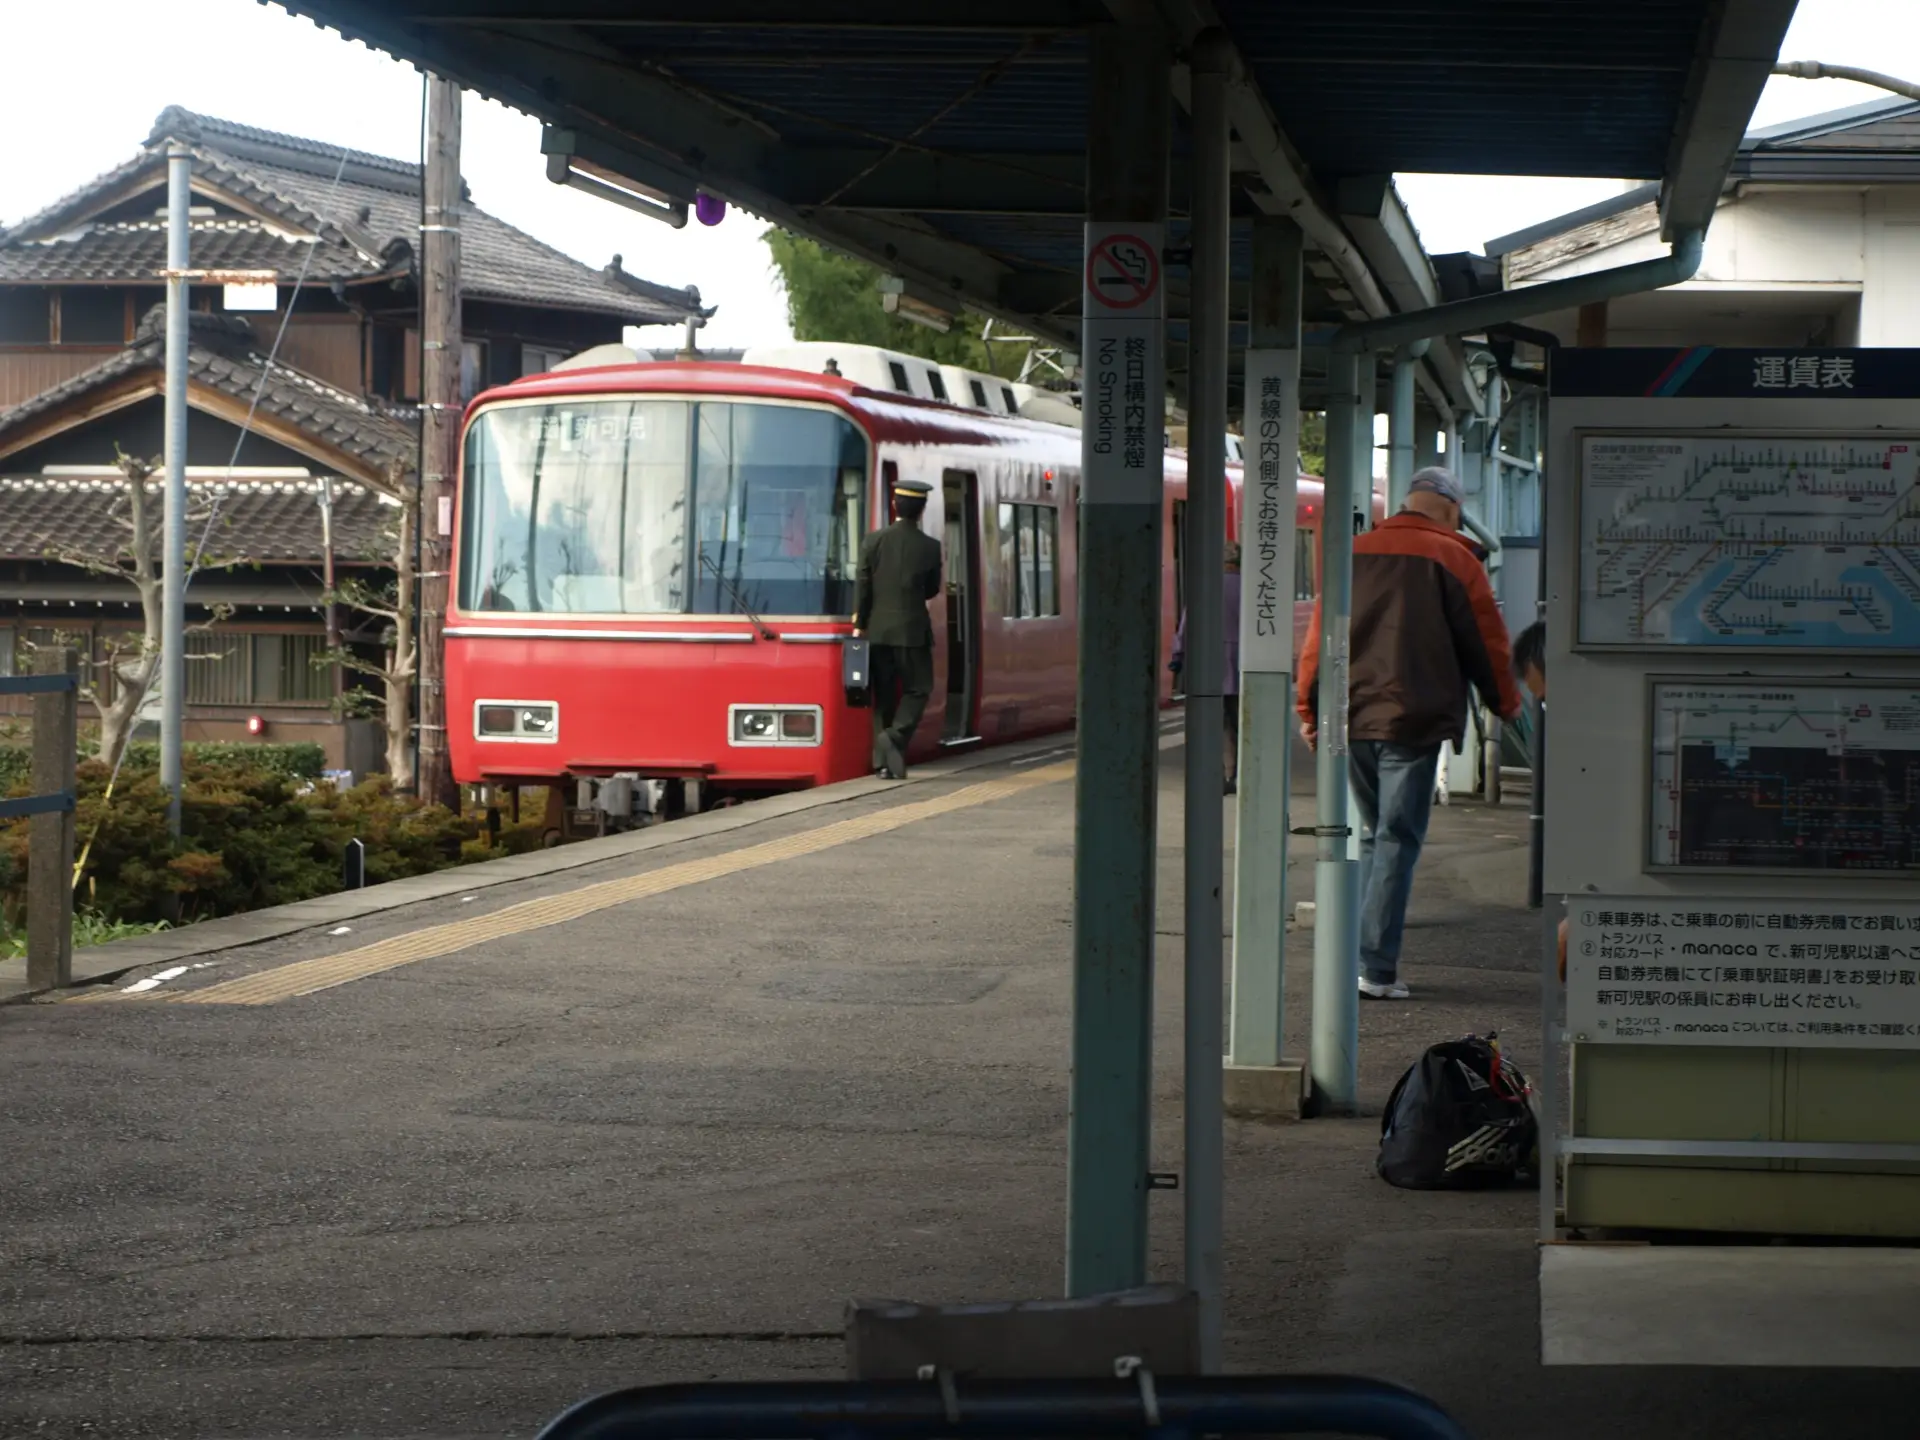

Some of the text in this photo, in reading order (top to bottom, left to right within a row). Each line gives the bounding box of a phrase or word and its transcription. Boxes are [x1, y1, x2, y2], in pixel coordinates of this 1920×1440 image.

[1752, 356, 1855, 389] 運賃表
[1094, 338, 1117, 455] No Smoking
[1123, 336, 1146, 469] 終日構内禁煙
[1256, 376, 1282, 636] 黄線の内側でお待ちください
[1600, 946, 1664, 960] 対応カード
[1681, 943, 1757, 956] manaca
[1598, 965, 1920, 987] 自動券売機にて「乗車駅証明書」をお受け取
[1596, 989, 1862, 1009] 新可児駅の係員にお申し出ください。
[1674, 1023, 1729, 1034] manaca
[1732, 1021, 1920, 1036] については、ご利用条件をご確認く
